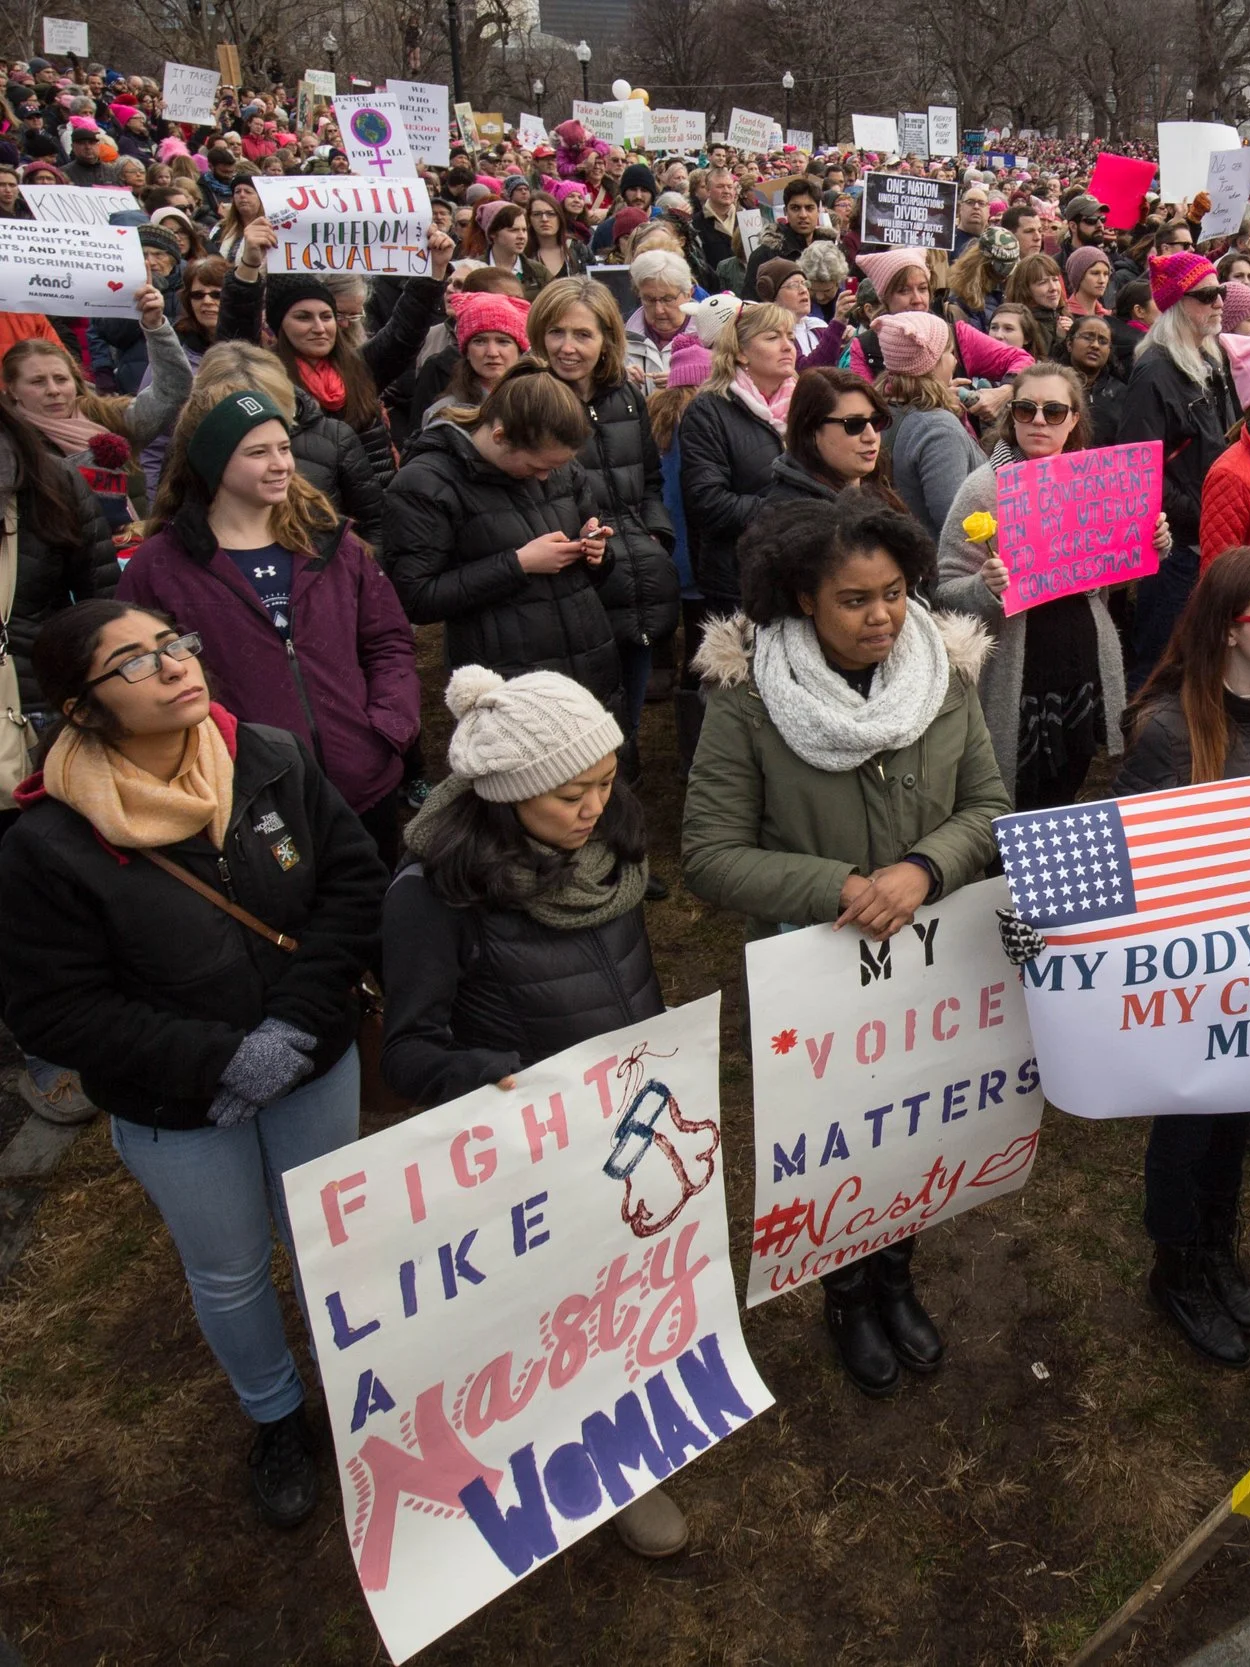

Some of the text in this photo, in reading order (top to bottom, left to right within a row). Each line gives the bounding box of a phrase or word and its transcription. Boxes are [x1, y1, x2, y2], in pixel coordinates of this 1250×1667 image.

[172, 68, 213, 84] IT TAKES
[170, 84, 212, 98] A VILLAGE
[411, 86, 426, 94] WE
[408, 96, 429, 104] WHO
[400, 105, 438, 115] BELIEVE
[576, 104, 593, 115] Take
[601, 108, 623, 120] Stand
[585, 116, 614, 130] Against
[651, 114, 679, 124] Stand for
[739, 114, 765, 129] Stand for
[404, 123, 440, 133] REEDOM
[654, 125, 671, 134] Peace
[735, 122, 760, 137] Freedom
[648, 135, 667, 144] Justice
[668, 134, 676, 143] for
[351, 149, 406, 158] FOR ALL
[886, 178, 938, 198] ONE NATION
[878, 193, 944, 209] UNDER CORPORATIONS
[894, 205, 928, 221] DIVIDED
[0, 224, 37, 232] TAND
[64, 229, 90, 237] FOR
[311, 220, 408, 246] FREEDOM
[877, 218, 943, 233] WITH LIBERTY AND JUSTICE
[17, 235, 77, 246] DIGNITY,
[81, 240, 124, 250] EQUAL
[884, 228, 935, 247] FOR THE 1%
[29, 246, 56, 254] AND
[60, 248, 122, 260] FREEDOM
[285, 242, 430, 274] EQUALITY
[14, 256, 124, 273] DISCRIMINATION
[237, 397, 263, 416] D
[1000, 447, 1152, 494] IF I WANTED
[1000, 491, 1032, 521] THE
[1003, 492, 1149, 549] IN MY UTERUS
[1050, 527, 1114, 562] SCREW
[1124, 521, 1141, 542] A
[1019, 546, 1143, 603] CONGRESSMAN
[860, 918, 939, 987] MY
[1022, 951, 1108, 991] MY
[1120, 984, 1206, 1030] MY
[773, 1057, 1040, 1183] MATTERS
[320, 1055, 620, 1248] FIGHT
[325, 1191, 551, 1351] LIKE
[345, 1221, 711, 1592] Nasty
[350, 1369, 396, 1434] A
